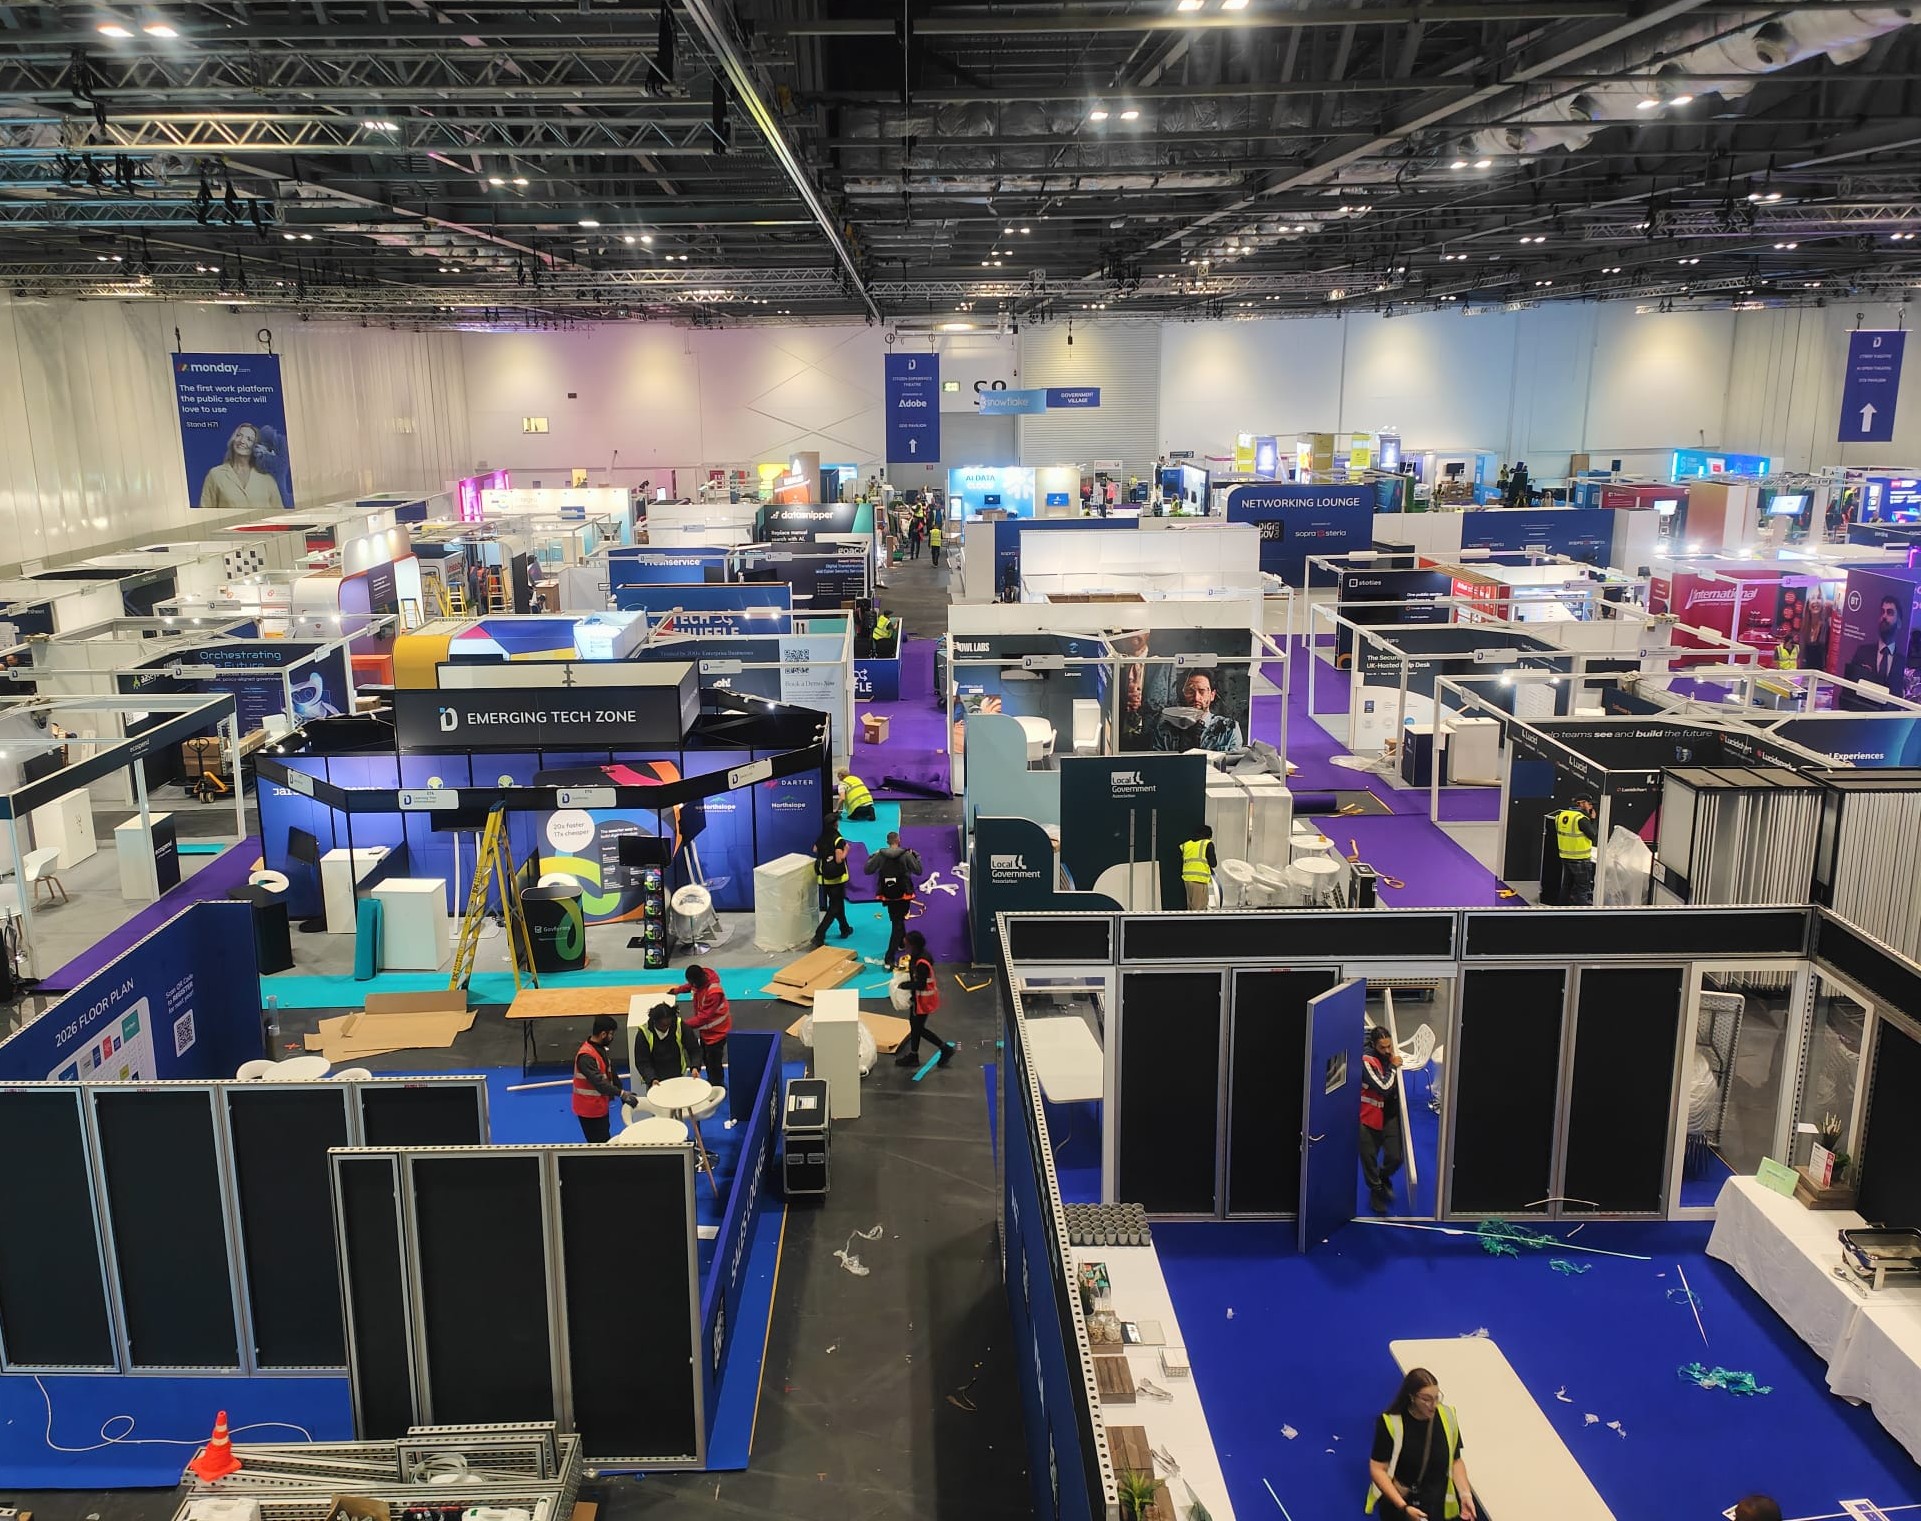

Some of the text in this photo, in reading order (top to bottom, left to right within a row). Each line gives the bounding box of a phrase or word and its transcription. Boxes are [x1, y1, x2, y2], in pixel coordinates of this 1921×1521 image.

[179, 384, 274, 394] The first work platform
[181, 395, 195, 403] the
[197, 395, 222, 404] public
[898, 399, 928, 407] Adobe
[182, 405, 200, 413] love
[1241, 497, 1360, 508] NETWORKING LOUNGE
[781, 511, 834, 520] datasnipper
[1690, 588, 1759, 602] Internatinal
[960, 642, 990, 652] OWL LABS
[199, 650, 282, 660] Orchestrating
[467, 711, 547, 725] EMERGING
[551, 710, 591, 724] TECH
[595, 710, 637, 723] ZONE
[1561, 730, 1592, 739] teams
[1594, 731, 1612, 739] see
[1614, 730, 1634, 739] and
[1635, 730, 1663, 739] build
[1664, 730, 1680, 739] the
[1682, 730, 1713, 739] future
[1833, 751, 1884, 760] Experiences
[1112, 776, 1132, 784] Local
[1112, 785, 1157, 794] Government
[992, 860, 1013, 869] Local
[992, 870, 1041, 879] Government
[172, 981, 194, 1003] REGISTER
[55, 977, 134, 1048] 2026 FLOOR PLAN
[732, 1137, 766, 1289] SALES LOUNGE
